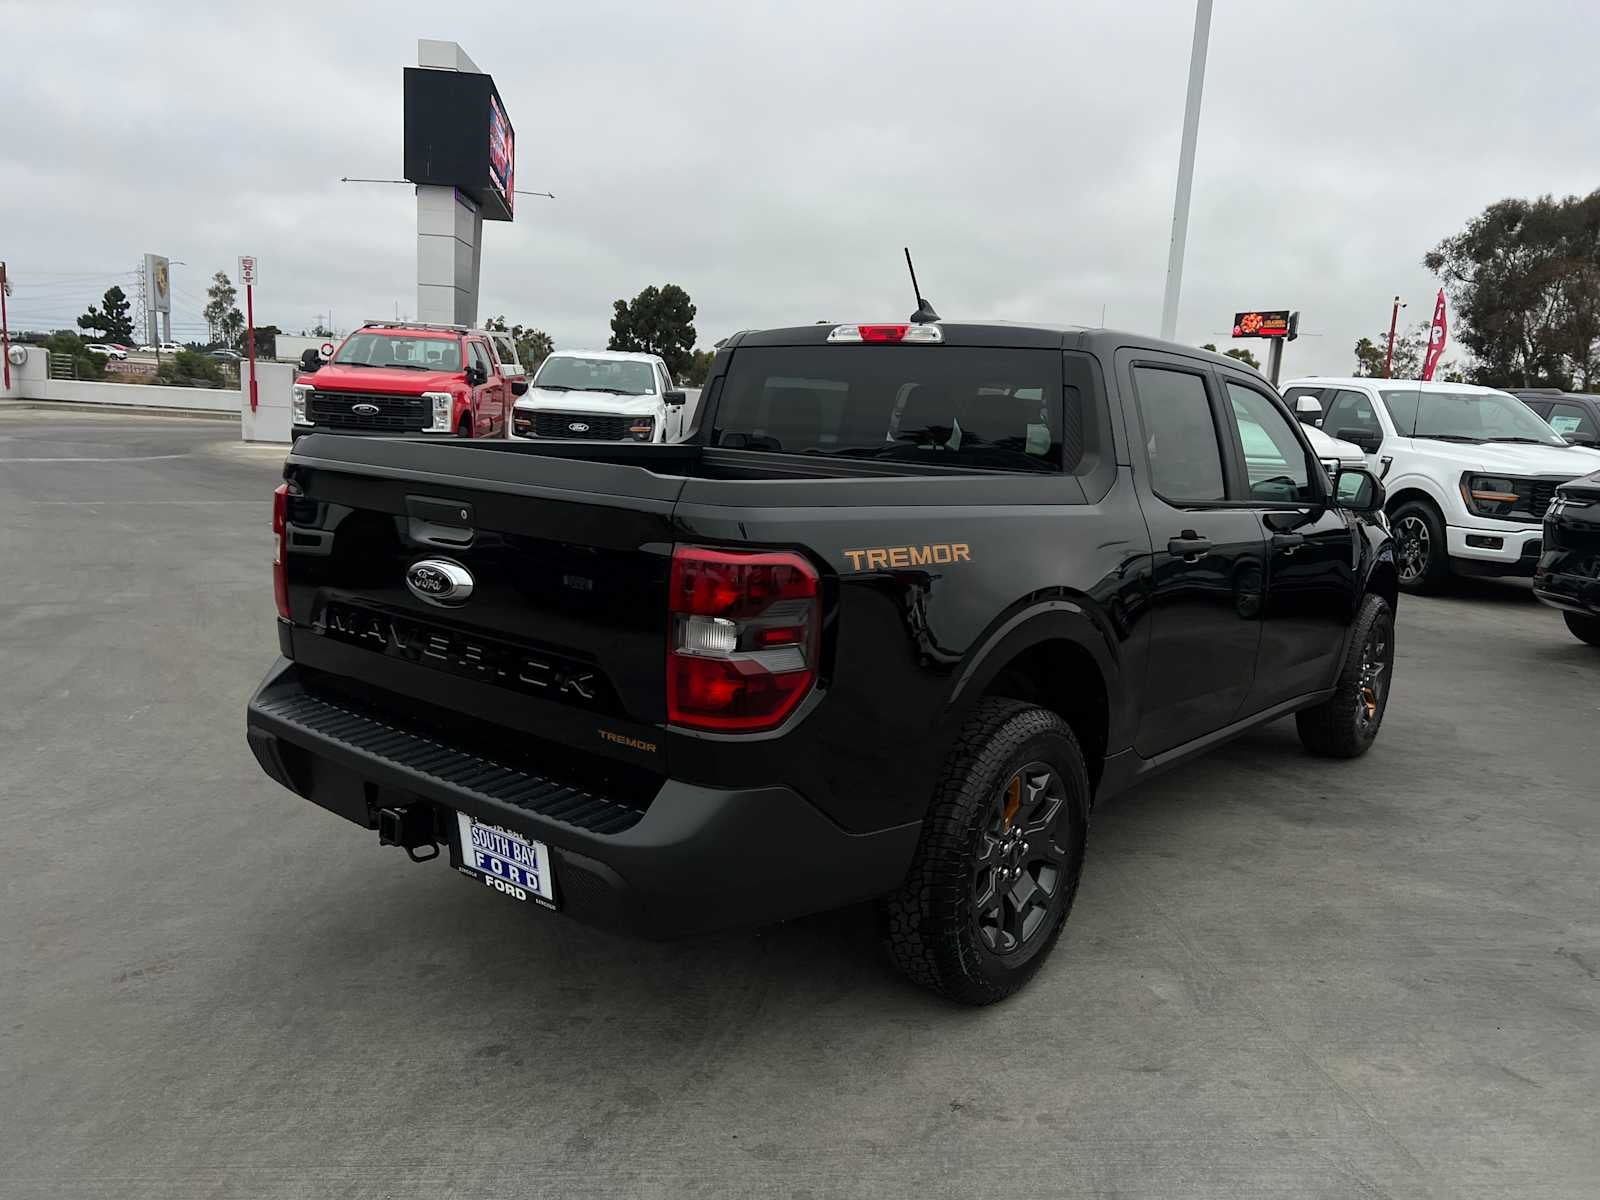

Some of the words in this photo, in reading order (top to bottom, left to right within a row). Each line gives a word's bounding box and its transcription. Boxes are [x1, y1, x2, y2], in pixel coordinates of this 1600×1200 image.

[844, 543, 971, 571] TREMOR
[414, 568, 442, 590] Ford
[329, 612, 594, 699] MAVERCK
[598, 728, 657, 752] TREMOR
[472, 826, 510, 857] SOUTH
[513, 842, 535, 867] BAY
[475, 851, 538, 890] FORD
[485, 874, 527, 901] FORD
